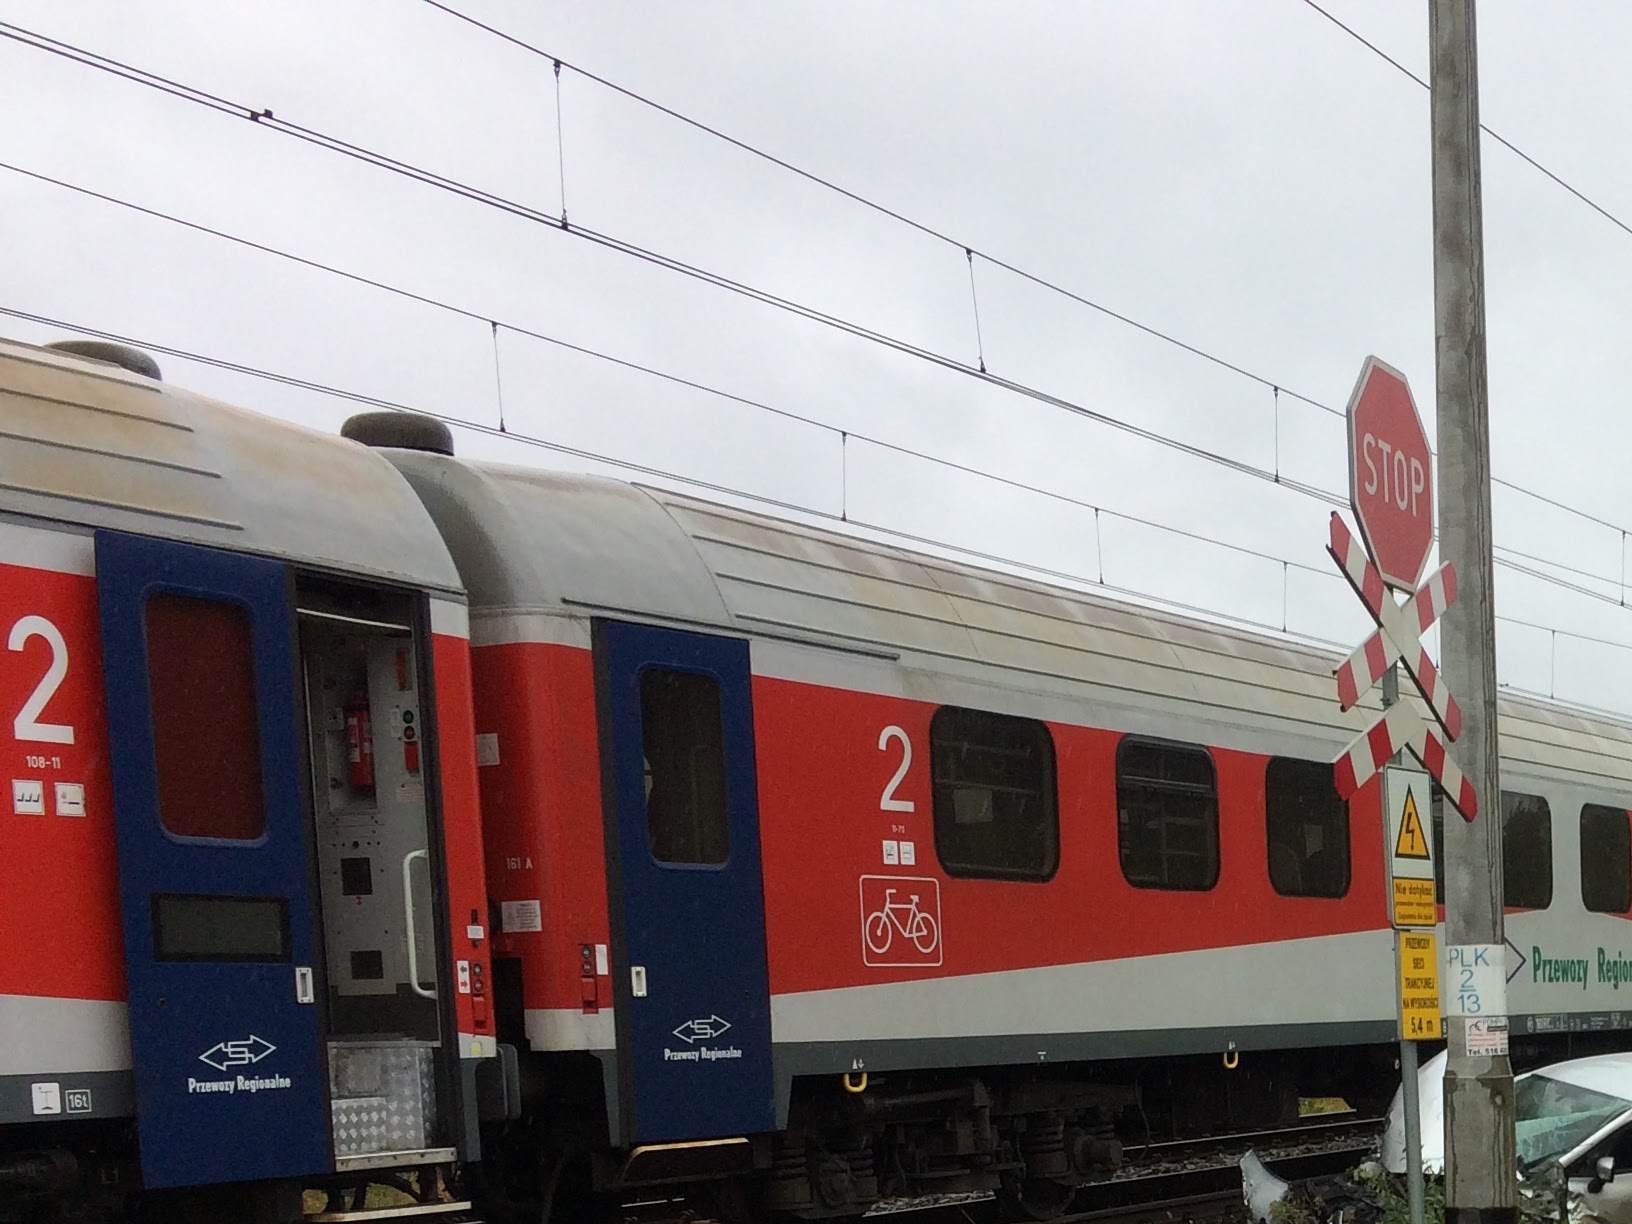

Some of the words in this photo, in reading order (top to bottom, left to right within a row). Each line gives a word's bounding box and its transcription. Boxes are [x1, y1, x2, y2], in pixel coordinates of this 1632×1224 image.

[1363, 432, 1425, 517] STOP
[8, 615, 75, 744] 2
[878, 725, 915, 813] 2
[525, 857, 533, 870] A
[1448, 947, 1490, 968] PLK
[1532, 945, 1589, 990] Przewozy
[1457, 993, 1481, 1014] 13
[1426, 1020, 1434, 1033] m
[664, 1048, 700, 1062] Przewozy
[700, 1045, 742, 1061] Regionalne
[188, 1077, 235, 1094] Przewozy
[236, 1073, 291, 1093] Regionalne
